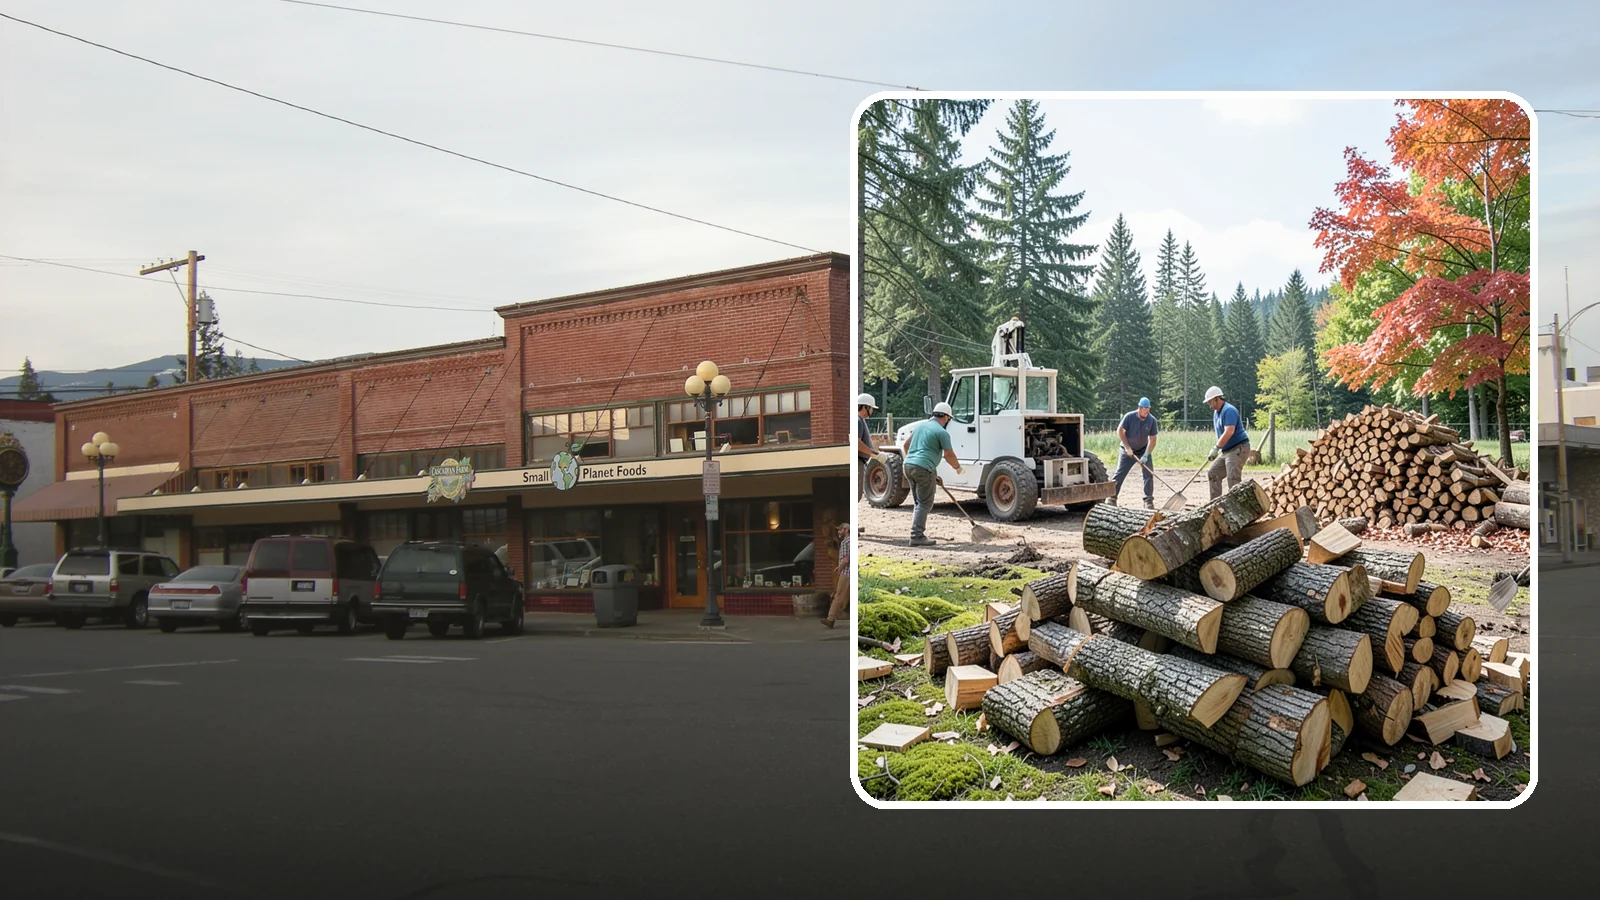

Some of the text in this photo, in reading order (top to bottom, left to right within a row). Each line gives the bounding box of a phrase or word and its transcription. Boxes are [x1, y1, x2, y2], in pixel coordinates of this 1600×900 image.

[523, 464, 647, 482] Small Planet Foods
